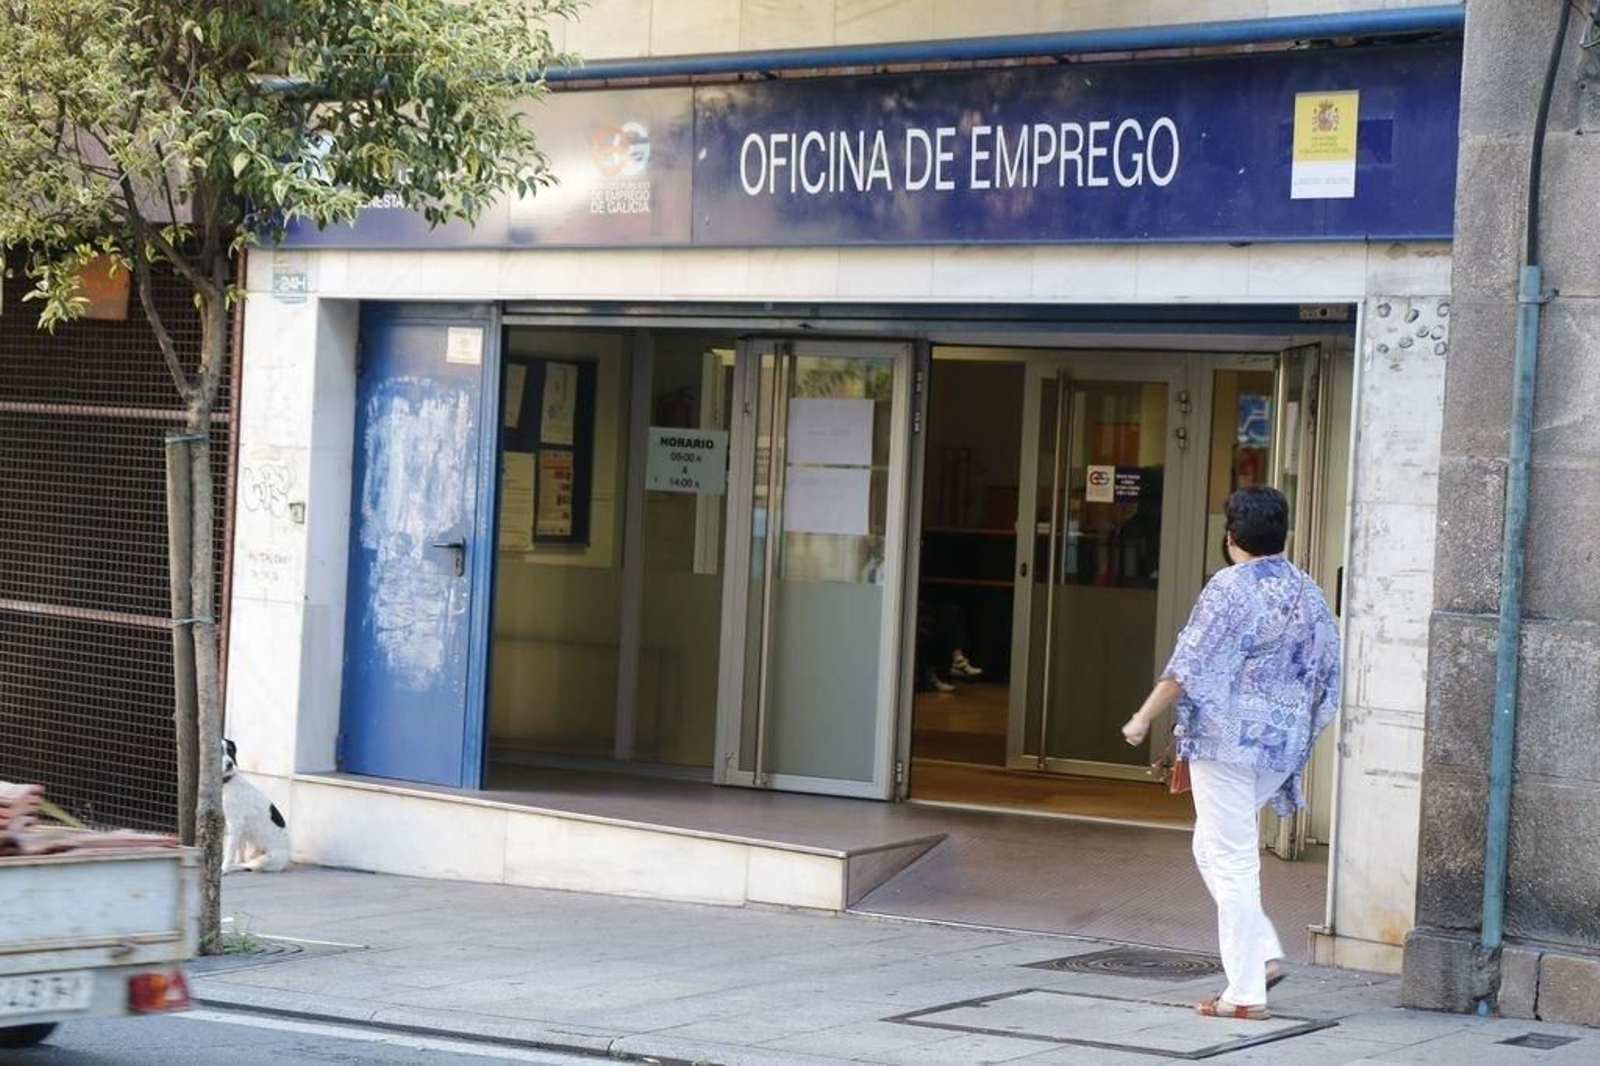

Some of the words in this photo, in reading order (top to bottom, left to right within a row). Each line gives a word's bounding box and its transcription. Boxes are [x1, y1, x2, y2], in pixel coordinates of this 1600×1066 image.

[739, 130, 893, 196] OFICINA
[904, 127, 956, 190] DE
[969, 116, 1179, 190] EMPREGO
[607, 200, 650, 213] GALICIA
[660, 437, 714, 449] HORARIO
